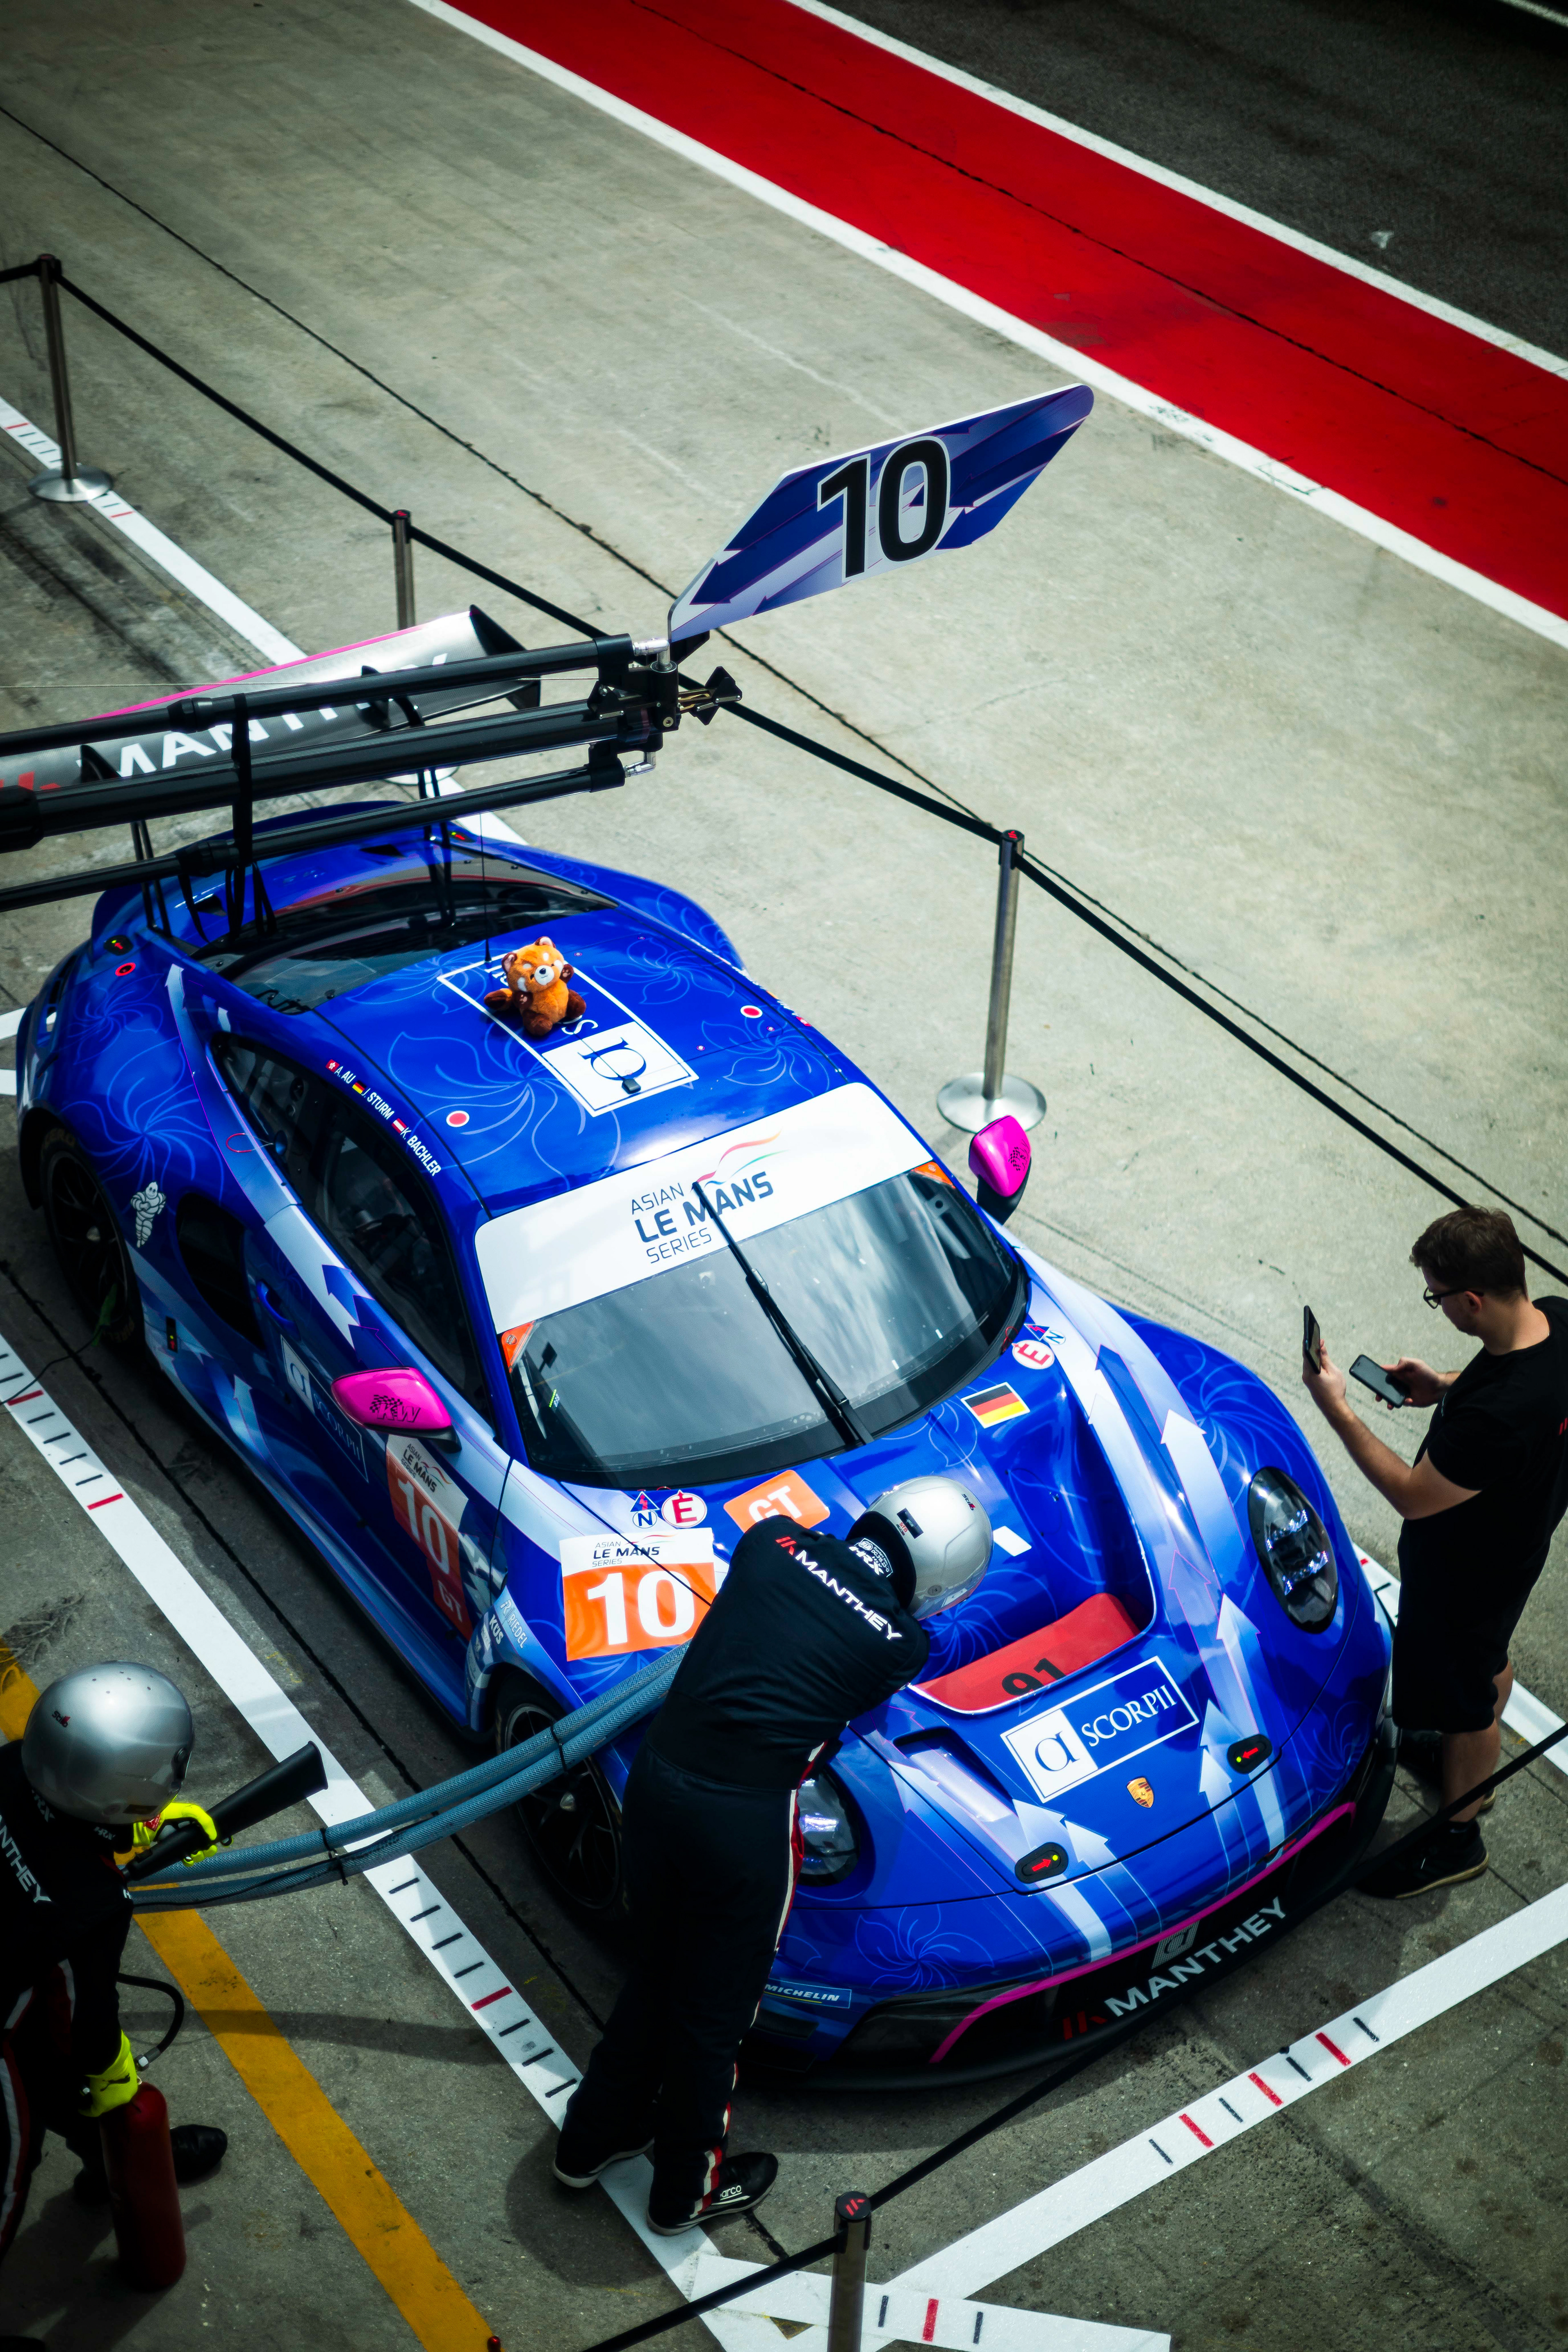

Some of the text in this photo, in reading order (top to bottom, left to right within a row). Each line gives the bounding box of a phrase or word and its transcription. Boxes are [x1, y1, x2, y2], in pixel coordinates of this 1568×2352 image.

[817, 436, 951, 583] 10
[334, 1066, 441, 1176] A. AU J. STURM K. BACHLER
[631, 1183, 684, 1214] ASIAN
[634, 1171, 774, 1243] LE MANS
[646, 1228, 712, 1264] SERIES
[1018, 1343, 1051, 1365] E
[377, 1403, 421, 1423] KW
[407, 1443, 421, 1460] ASIAN
[403, 1449, 437, 1492] LE MANS
[638, 1514, 653, 1525] N
[674, 1498, 697, 1523] E
[748, 1486, 802, 1522] GT
[398, 1478, 450, 1575] 10
[592, 1558, 622, 1567] SERIES
[593, 1546, 660, 1559] LE MANS
[437, 1580, 462, 1623] GT
[588, 1570, 695, 1645] 10
[795, 1550, 902, 1640] MANTHEY
[508, 1613, 528, 1648] RIEDEL
[1002, 1658, 1067, 1695] 91
[1081, 1684, 1178, 1747] SCORPII
[0, 1815, 52, 1903] NTHEY
[1104, 1896, 1290, 2017] MANTHEY
[764, 1984, 840, 2001] MICHELIN
